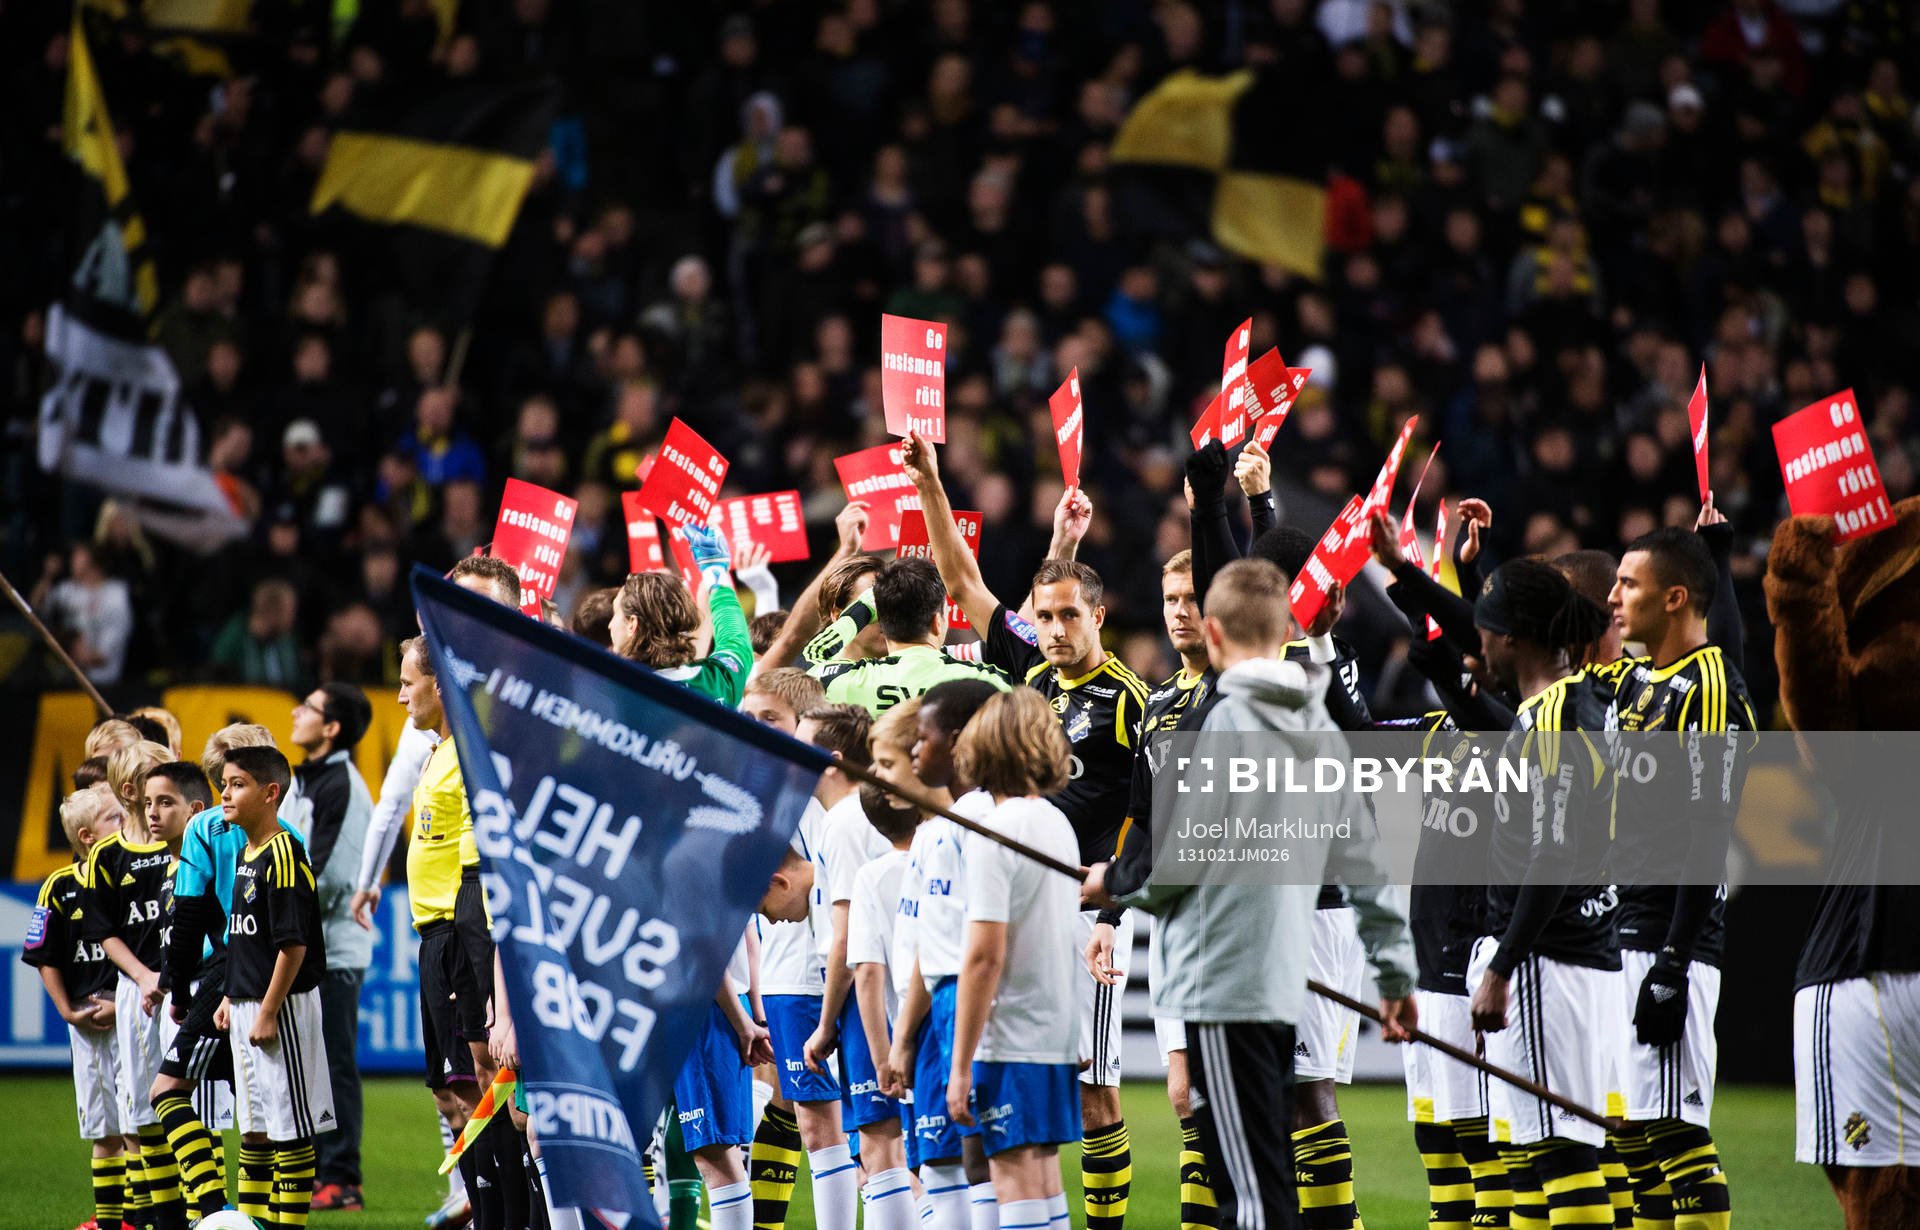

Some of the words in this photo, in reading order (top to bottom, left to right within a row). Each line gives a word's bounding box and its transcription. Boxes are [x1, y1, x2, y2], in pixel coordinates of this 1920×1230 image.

[926, 328, 943, 350] Ge
[884, 352, 942, 378] rasismen
[915, 386, 942, 408] rött
[1829, 401, 1855, 429] Ge
[662, 444, 719, 496] rasismen
[708, 454, 725, 478] Ge
[1784, 432, 1866, 485] rasismen
[1837, 463, 1877, 498] rött
[553, 499, 573, 521] Ge
[687, 488, 712, 515] rött
[502, 508, 568, 544] rasismen
[534, 545, 560, 568] rött
